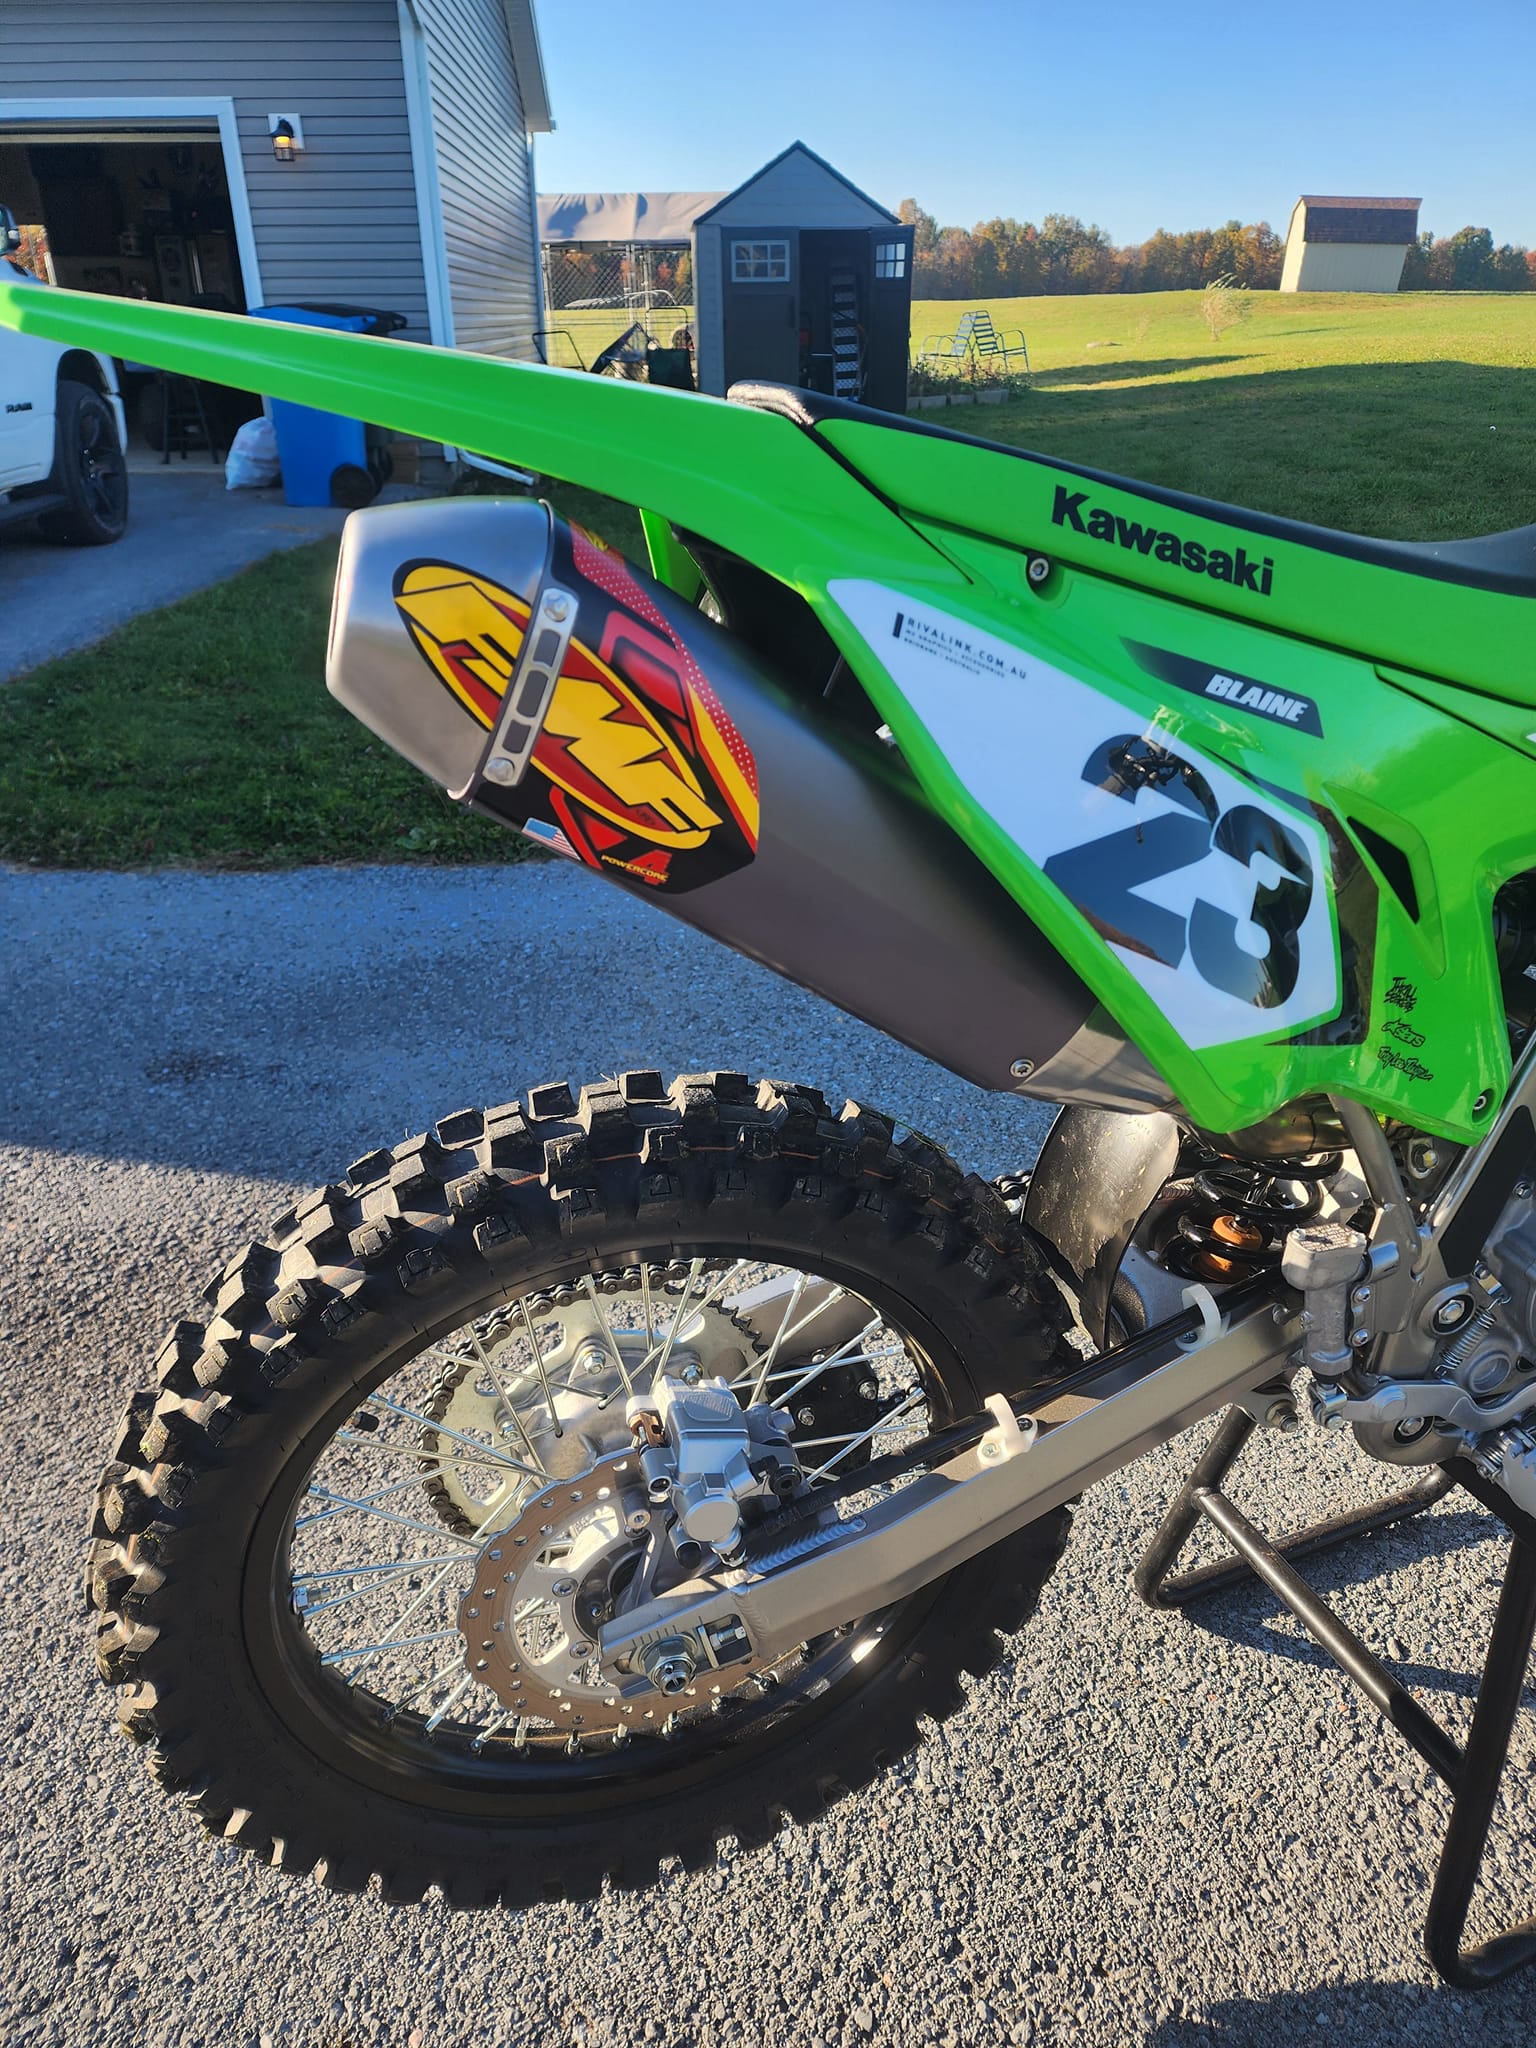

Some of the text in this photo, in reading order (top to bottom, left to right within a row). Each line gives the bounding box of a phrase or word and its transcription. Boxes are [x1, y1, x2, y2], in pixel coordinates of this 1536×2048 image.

[1052, 485, 1274, 596] Kawasaki
[1204, 673, 1309, 723] BLAINE
[601, 854, 669, 883] POWERCORE
[1042, 733, 1314, 1009] 23
